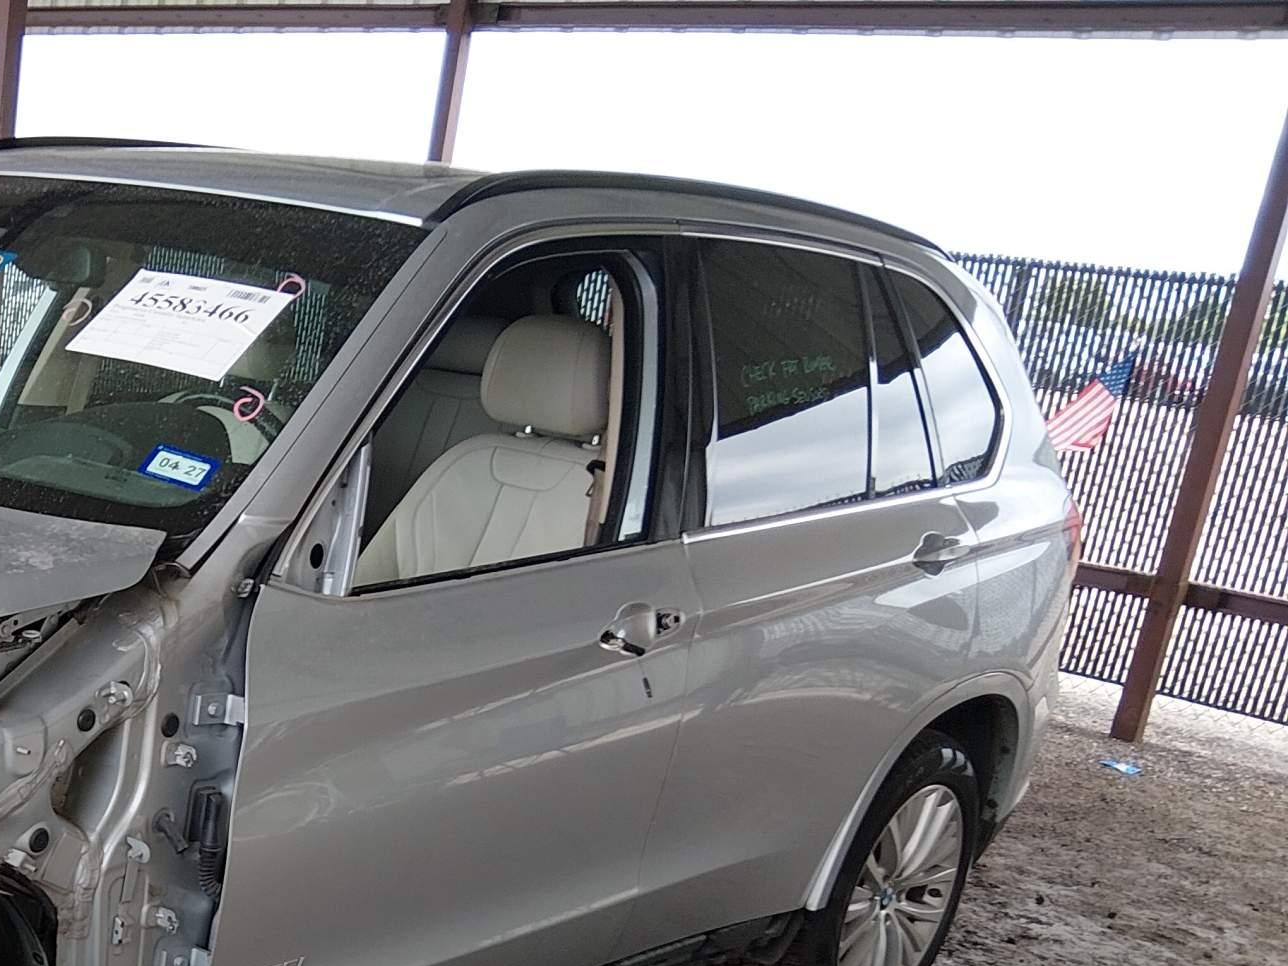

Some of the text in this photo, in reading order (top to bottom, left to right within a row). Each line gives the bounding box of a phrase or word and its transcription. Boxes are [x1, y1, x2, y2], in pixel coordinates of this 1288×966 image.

[129, 291, 256, 324] 45583466
[158, 457, 207, 478] 04 27
